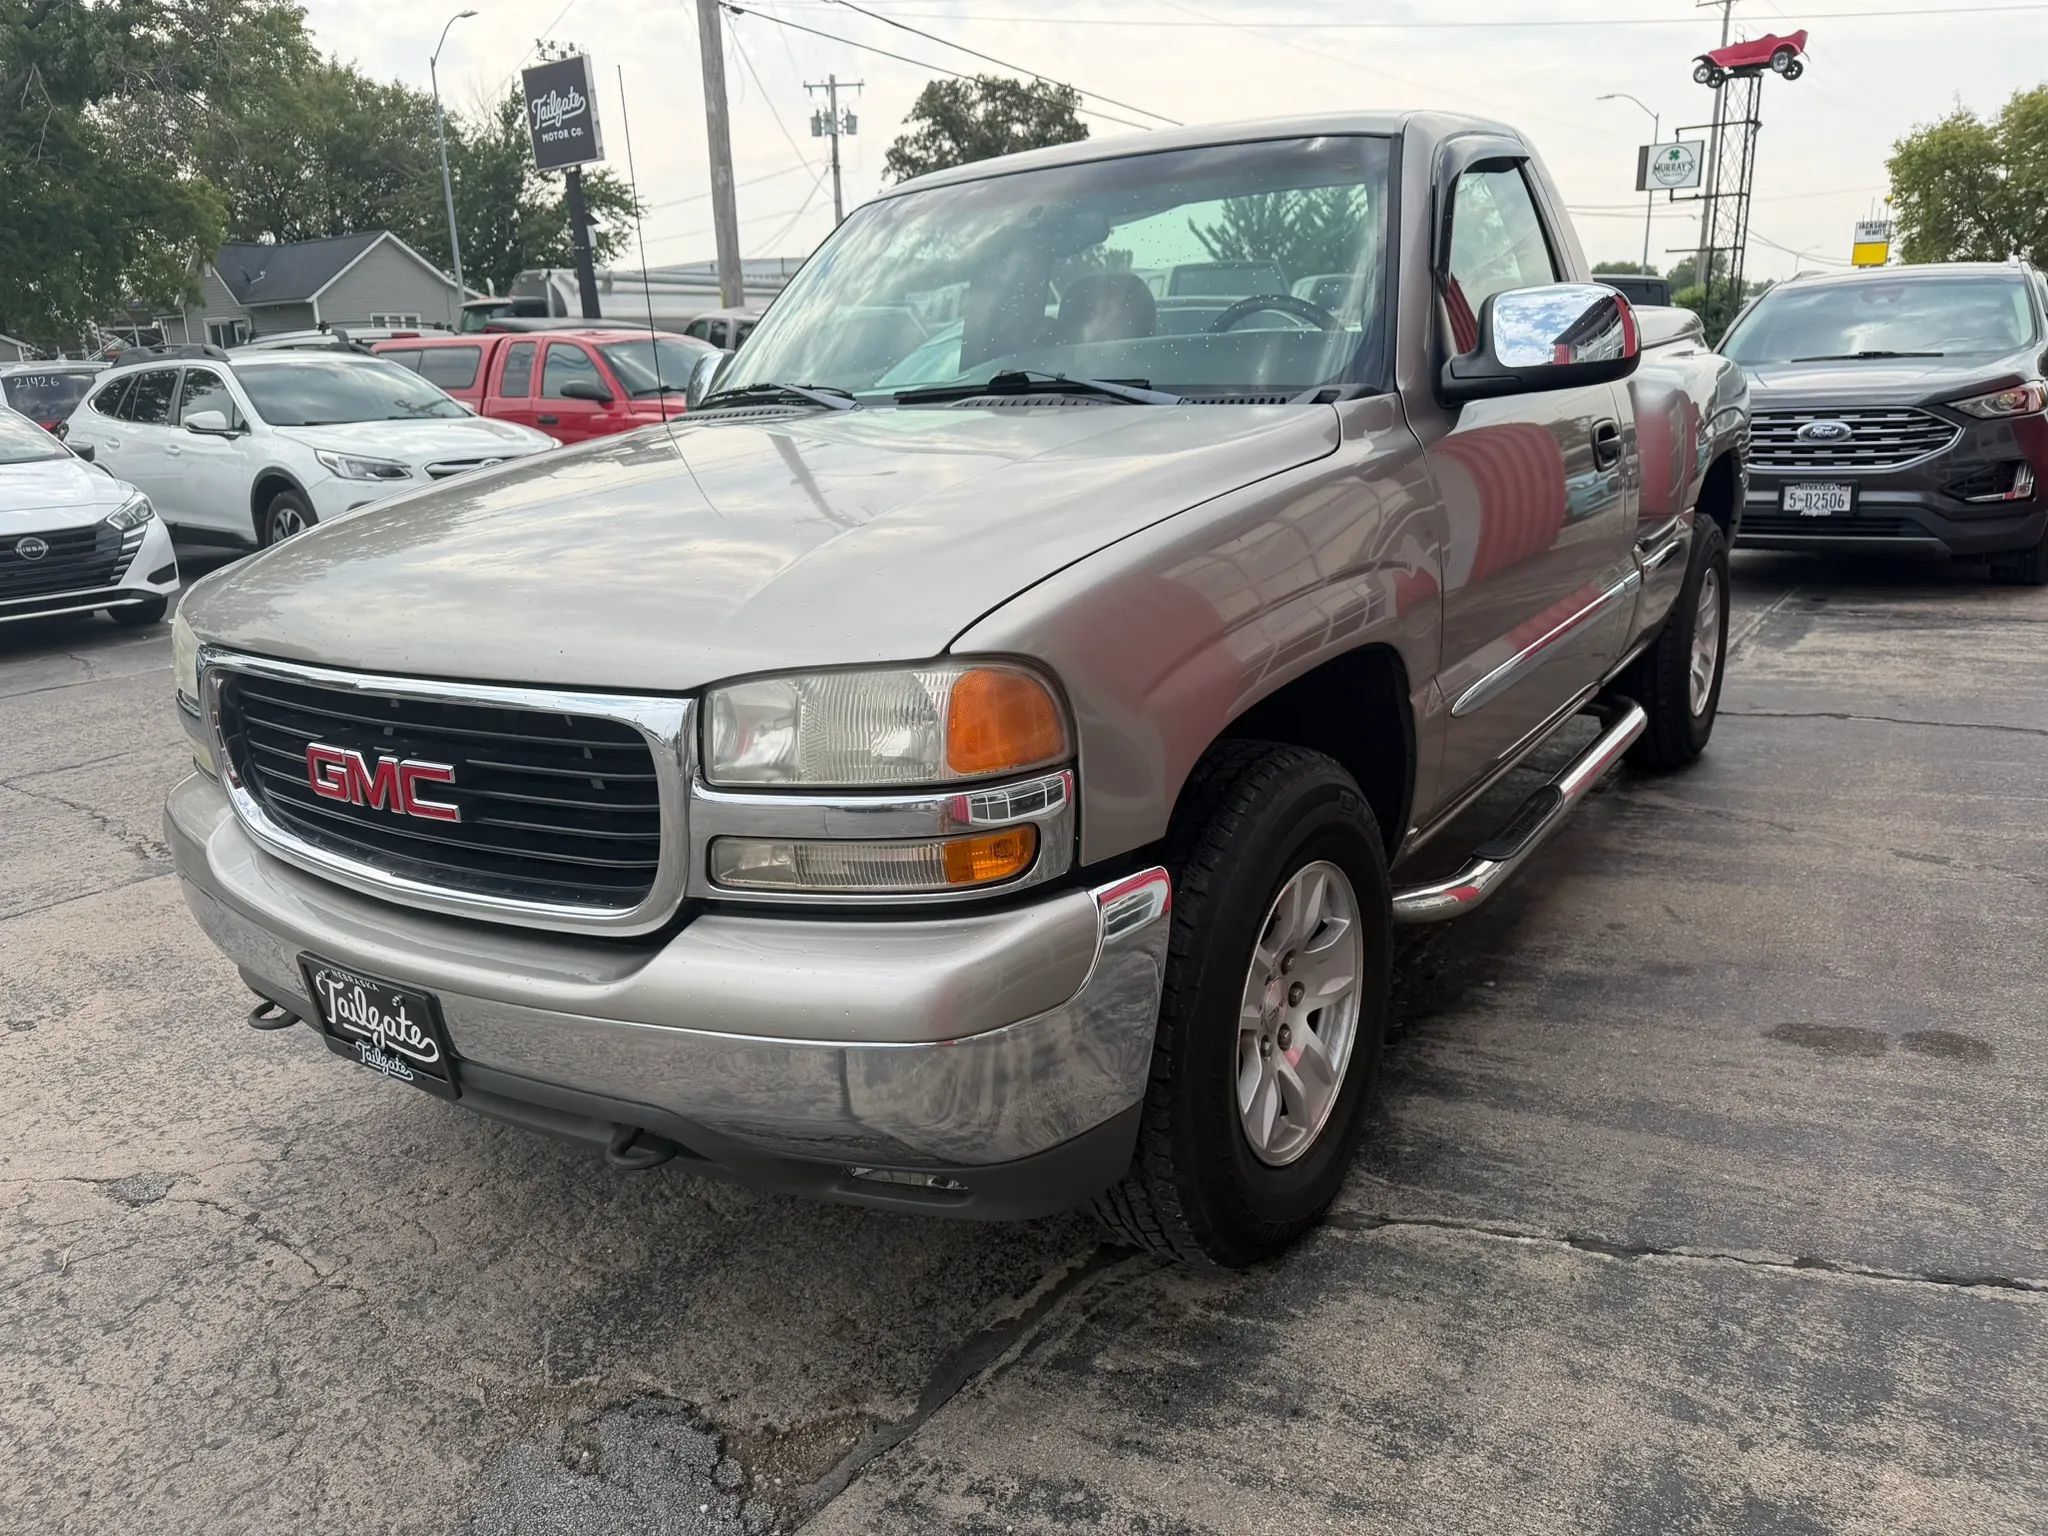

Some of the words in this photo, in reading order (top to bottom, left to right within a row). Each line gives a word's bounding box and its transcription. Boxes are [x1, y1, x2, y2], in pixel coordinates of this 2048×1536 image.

[531, 86, 586, 130] Tailgate
[542, 129, 569, 143] MOTOR
[571, 127, 585, 137] CO.
[1652, 160, 1696, 175] MURRAY'S
[14, 376, 60, 388] 21426
[1809, 424, 1839, 438] Ford
[16, 544, 49, 553] NISSAN
[305, 741, 462, 823] GMC
[331, 969, 380, 992] NEBRASKA
[316, 970, 440, 1063] Tailgate
[355, 1040, 414, 1081] Tailgate
